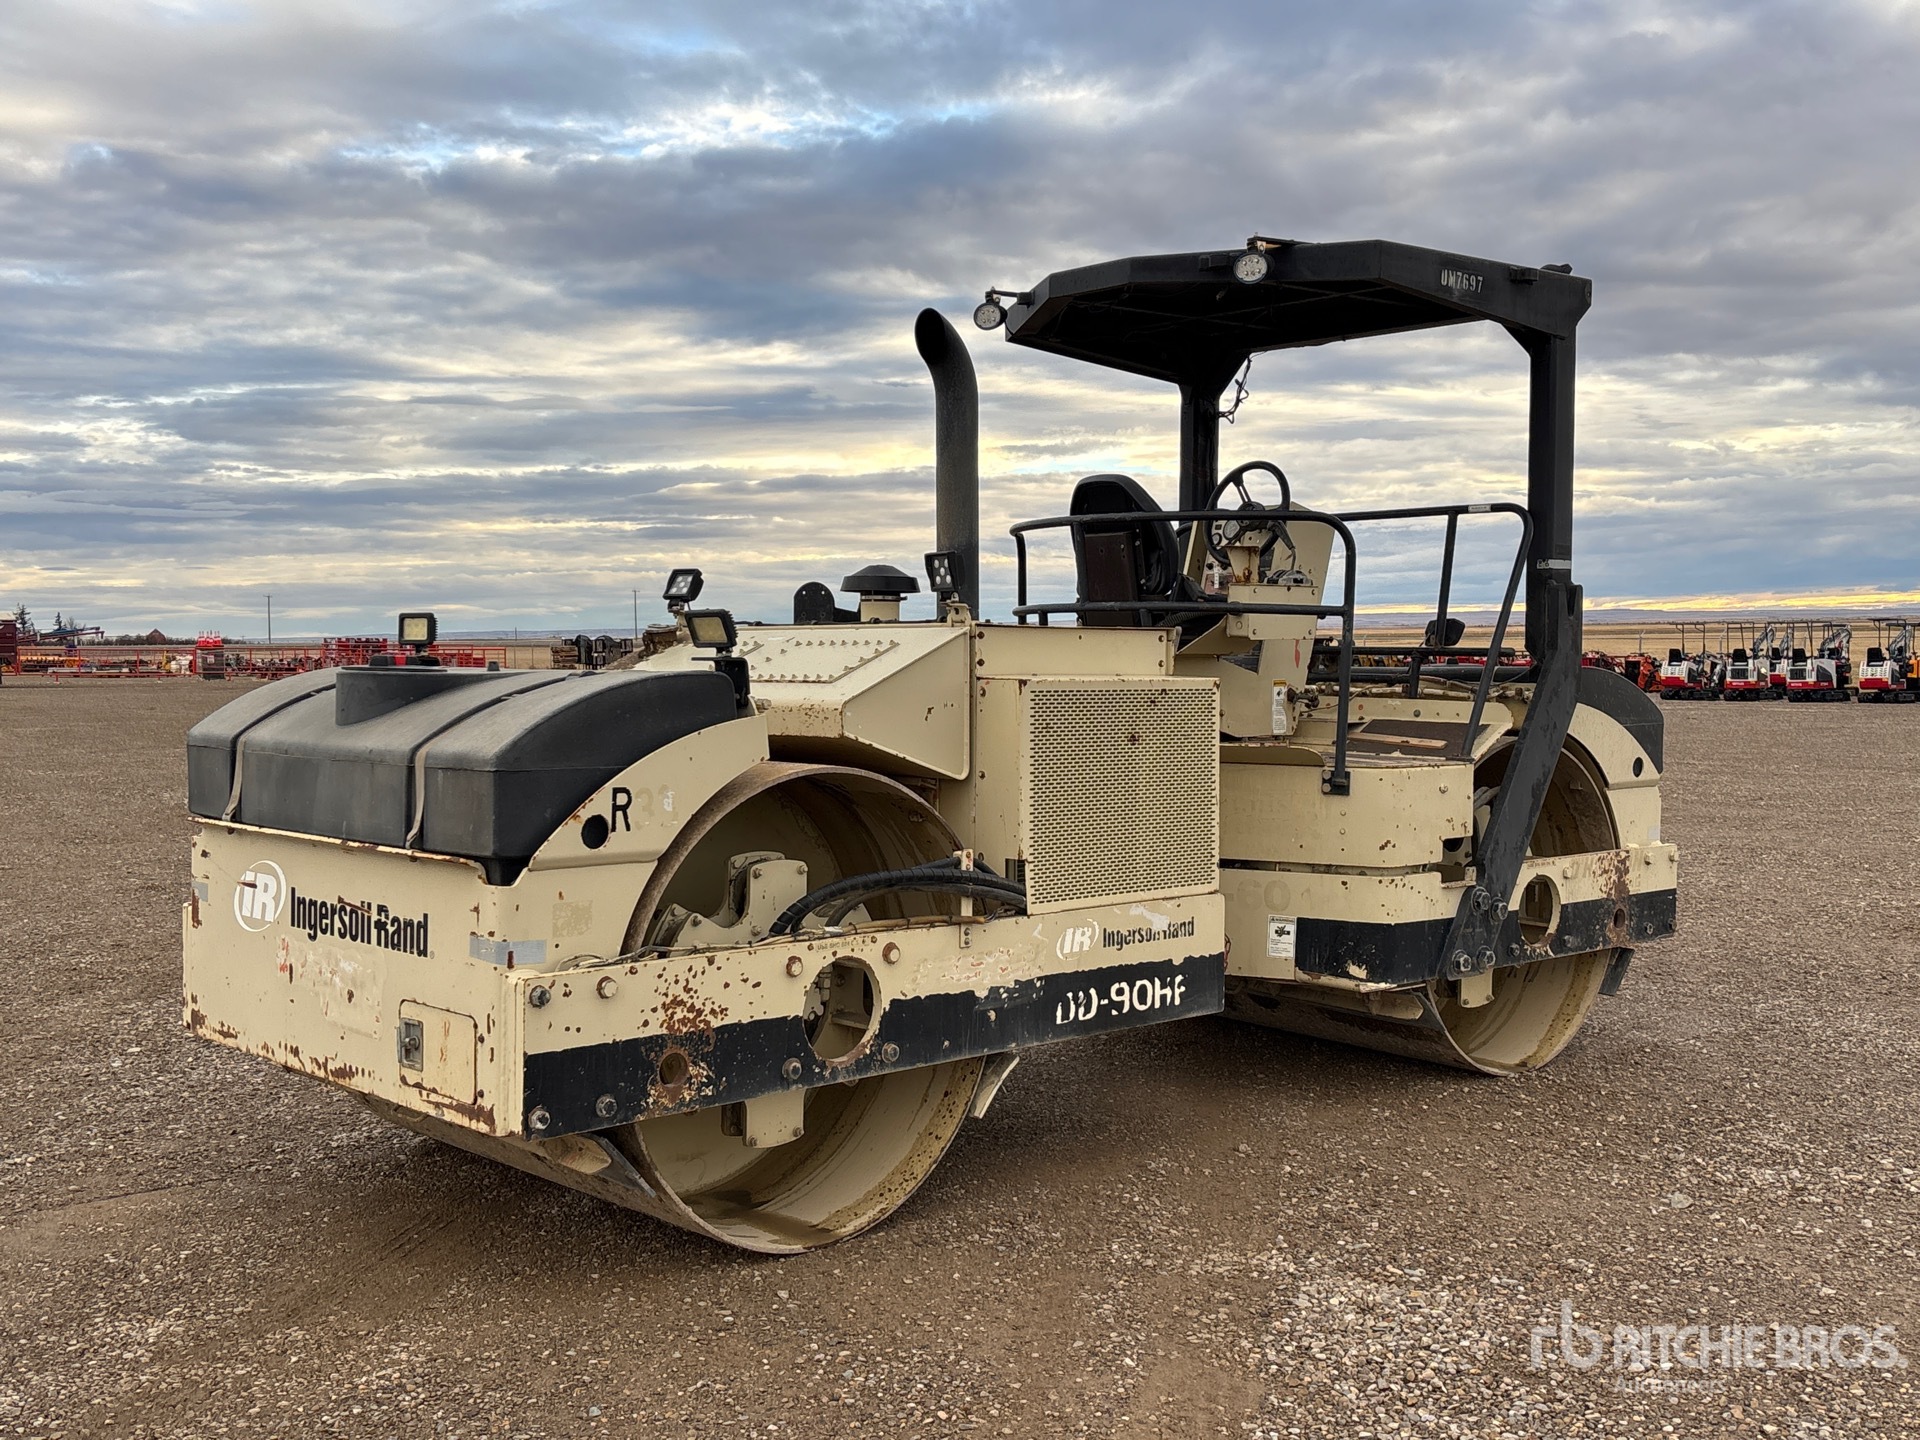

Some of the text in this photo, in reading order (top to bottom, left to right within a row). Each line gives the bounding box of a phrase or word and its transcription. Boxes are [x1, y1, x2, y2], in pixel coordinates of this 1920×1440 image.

[1441, 268, 1484, 294] UM7697
[290, 886, 429, 958] Ingersoll Rand
